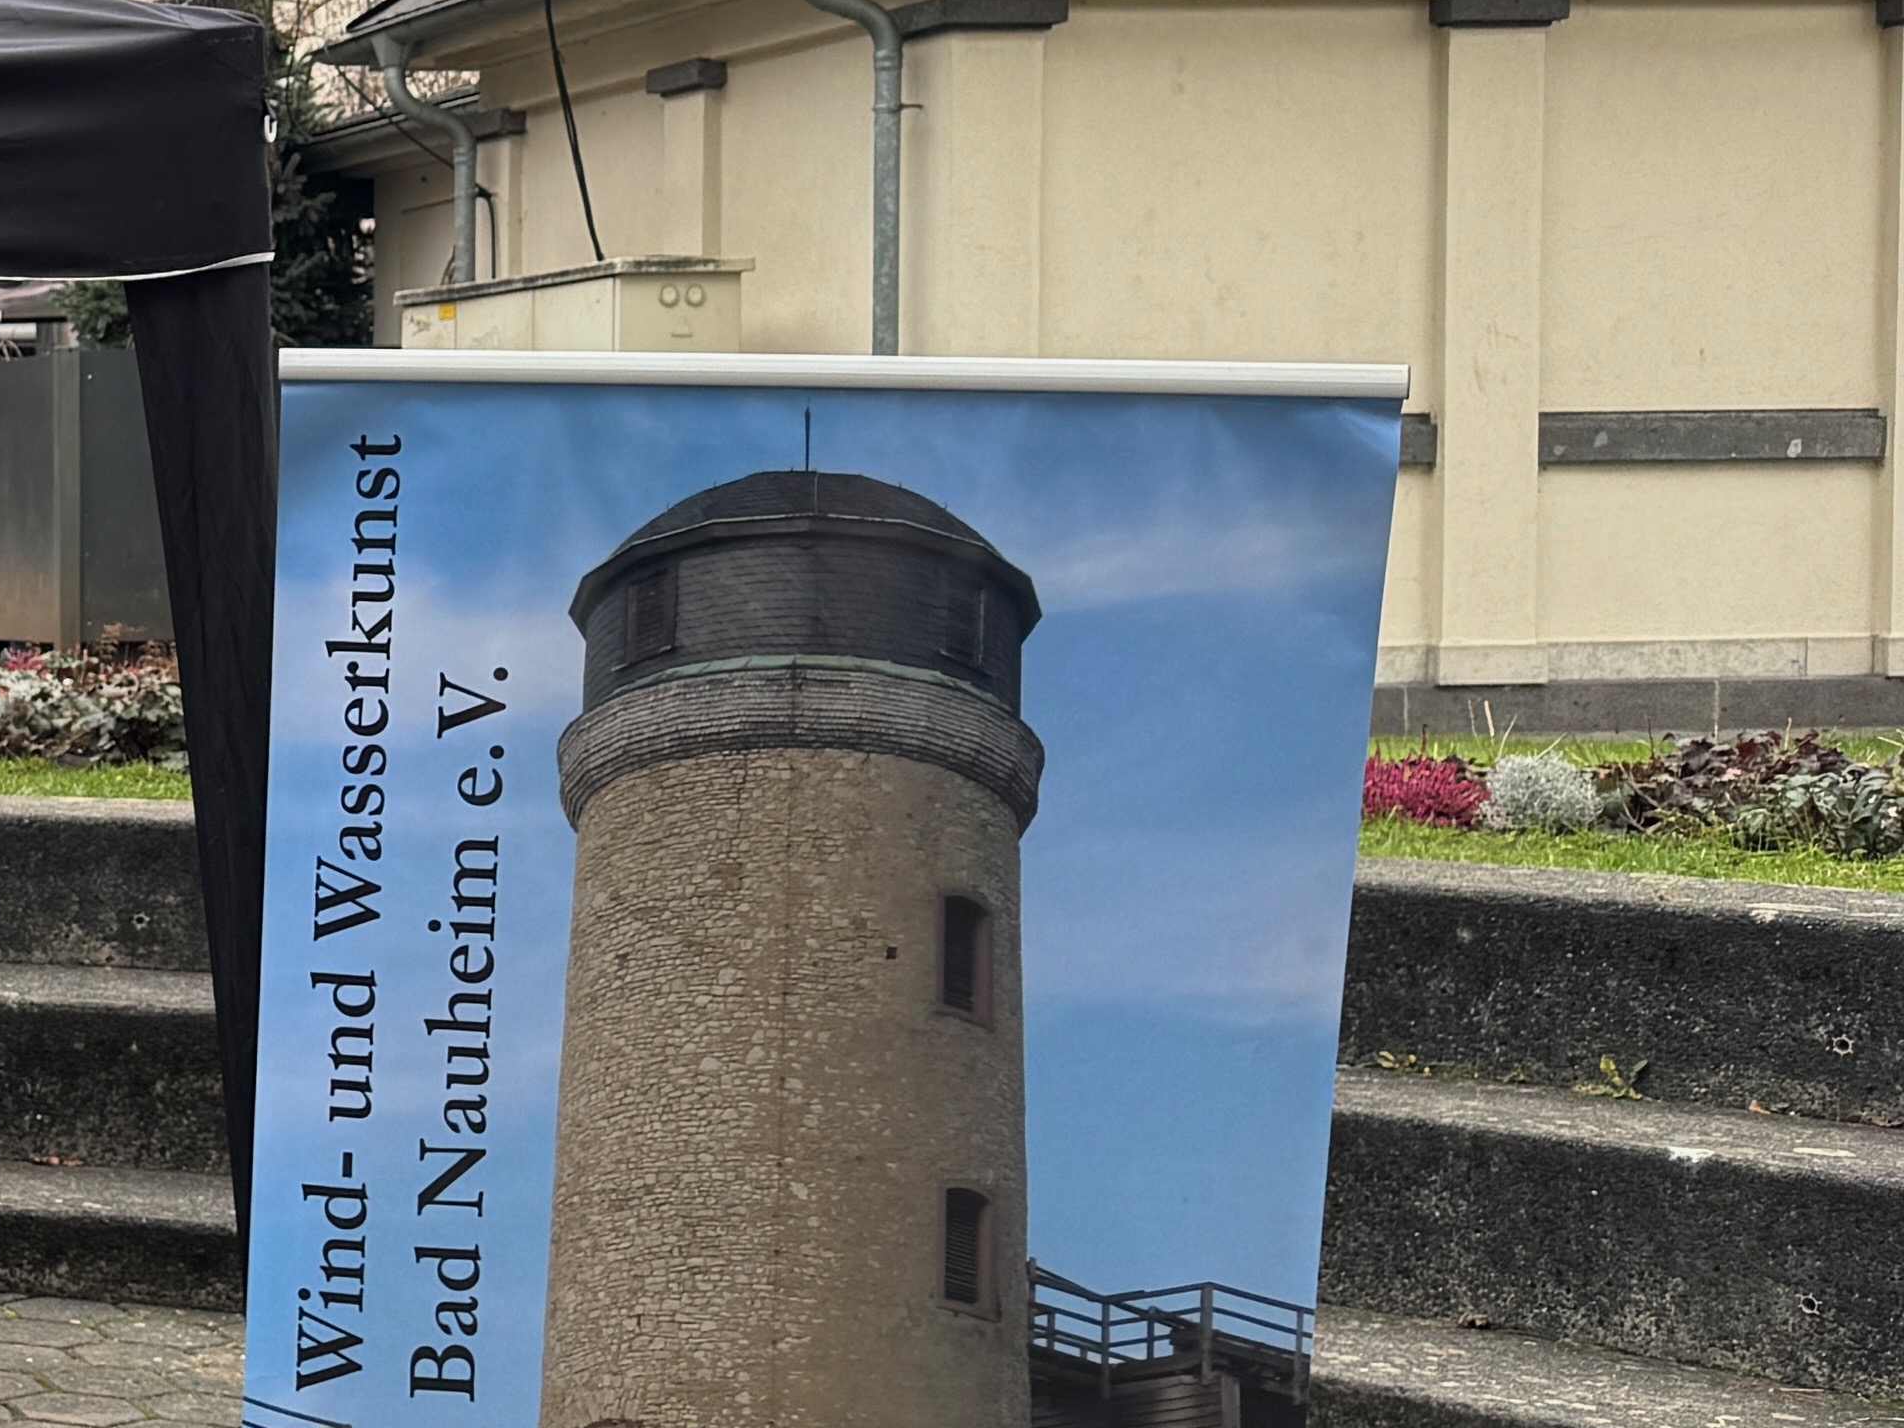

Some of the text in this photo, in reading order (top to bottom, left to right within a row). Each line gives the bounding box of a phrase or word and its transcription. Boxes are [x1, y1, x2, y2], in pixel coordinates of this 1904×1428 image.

[295, 433, 403, 1392] Wind- und Wasserkunst
[417, 835, 499, 1218] Nauheim
[409, 1244, 483, 1403] Bad
